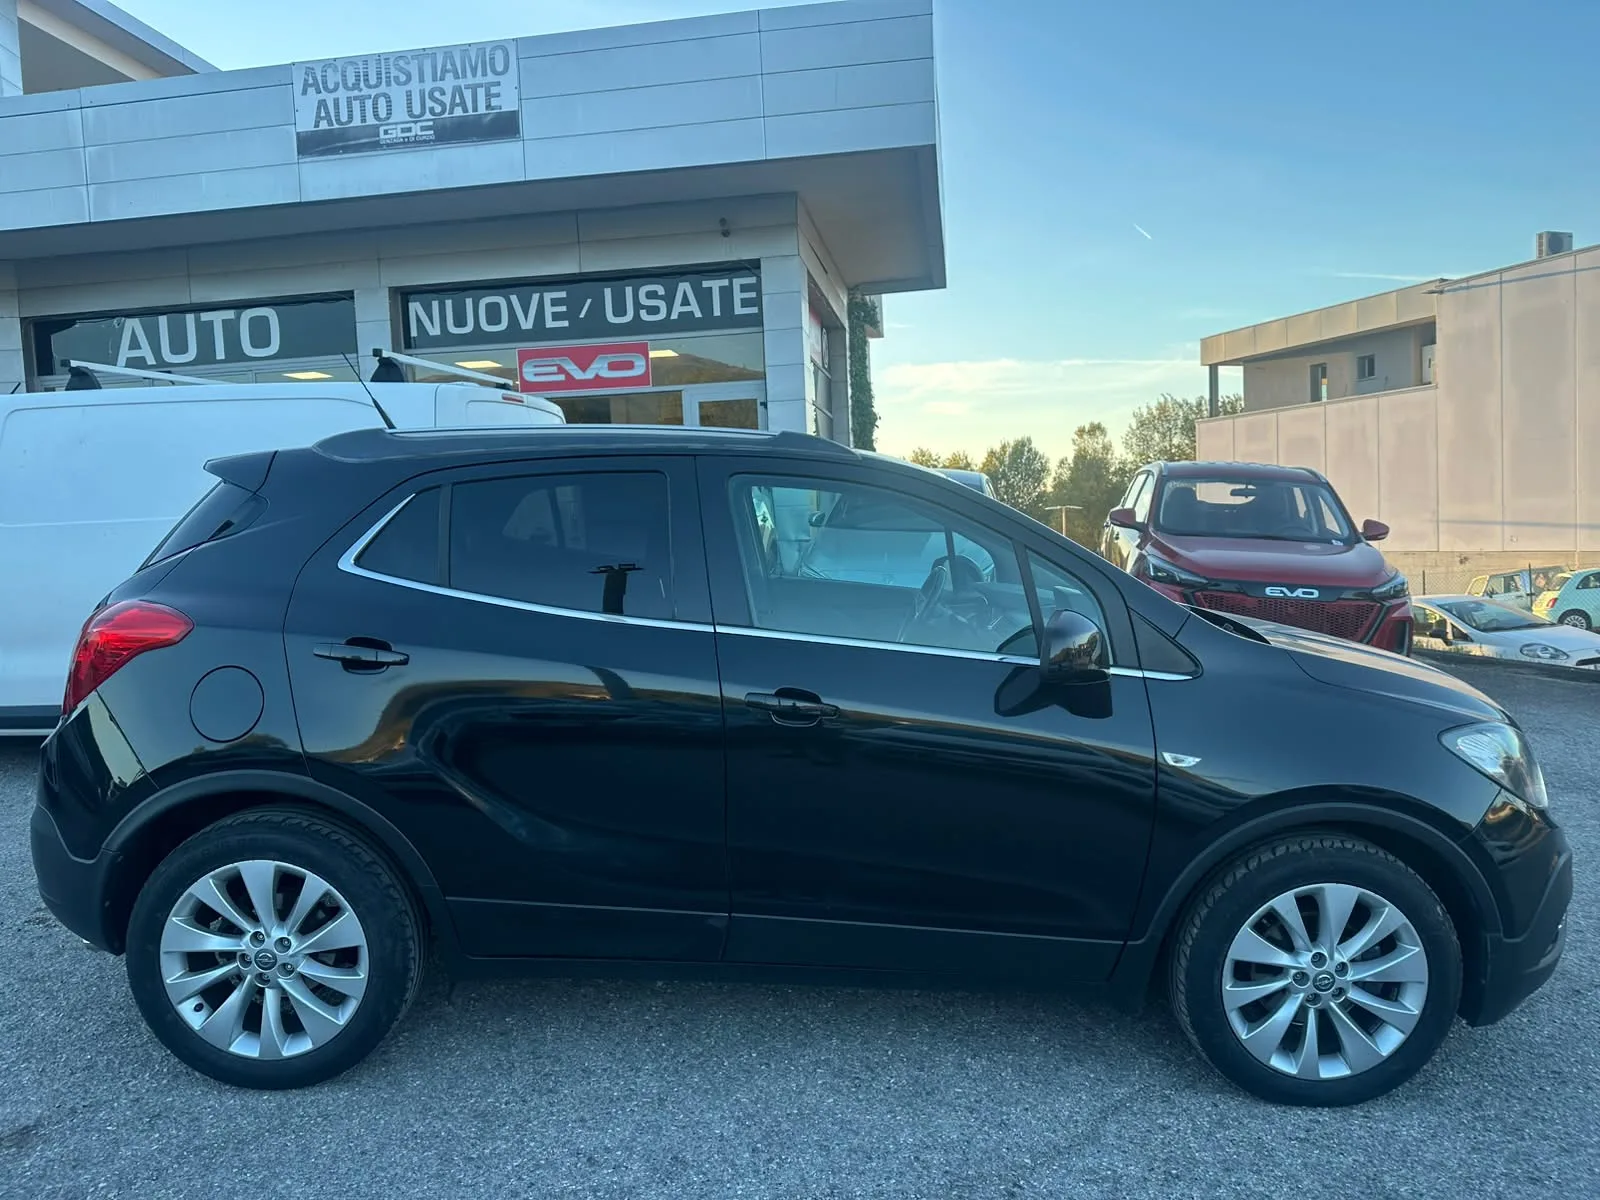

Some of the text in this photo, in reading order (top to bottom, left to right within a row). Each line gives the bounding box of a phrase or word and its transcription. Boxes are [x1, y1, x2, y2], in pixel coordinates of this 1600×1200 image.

[301, 45, 510, 96] ACQUISTIAMO
[313, 81, 502, 129] AUTO USATE
[408, 291, 569, 338] NUOVE
[605, 276, 758, 324] USATE
[117, 307, 280, 368] AUTO
[522, 353, 646, 382] EVO
[1265, 586, 1319, 598] EVO
